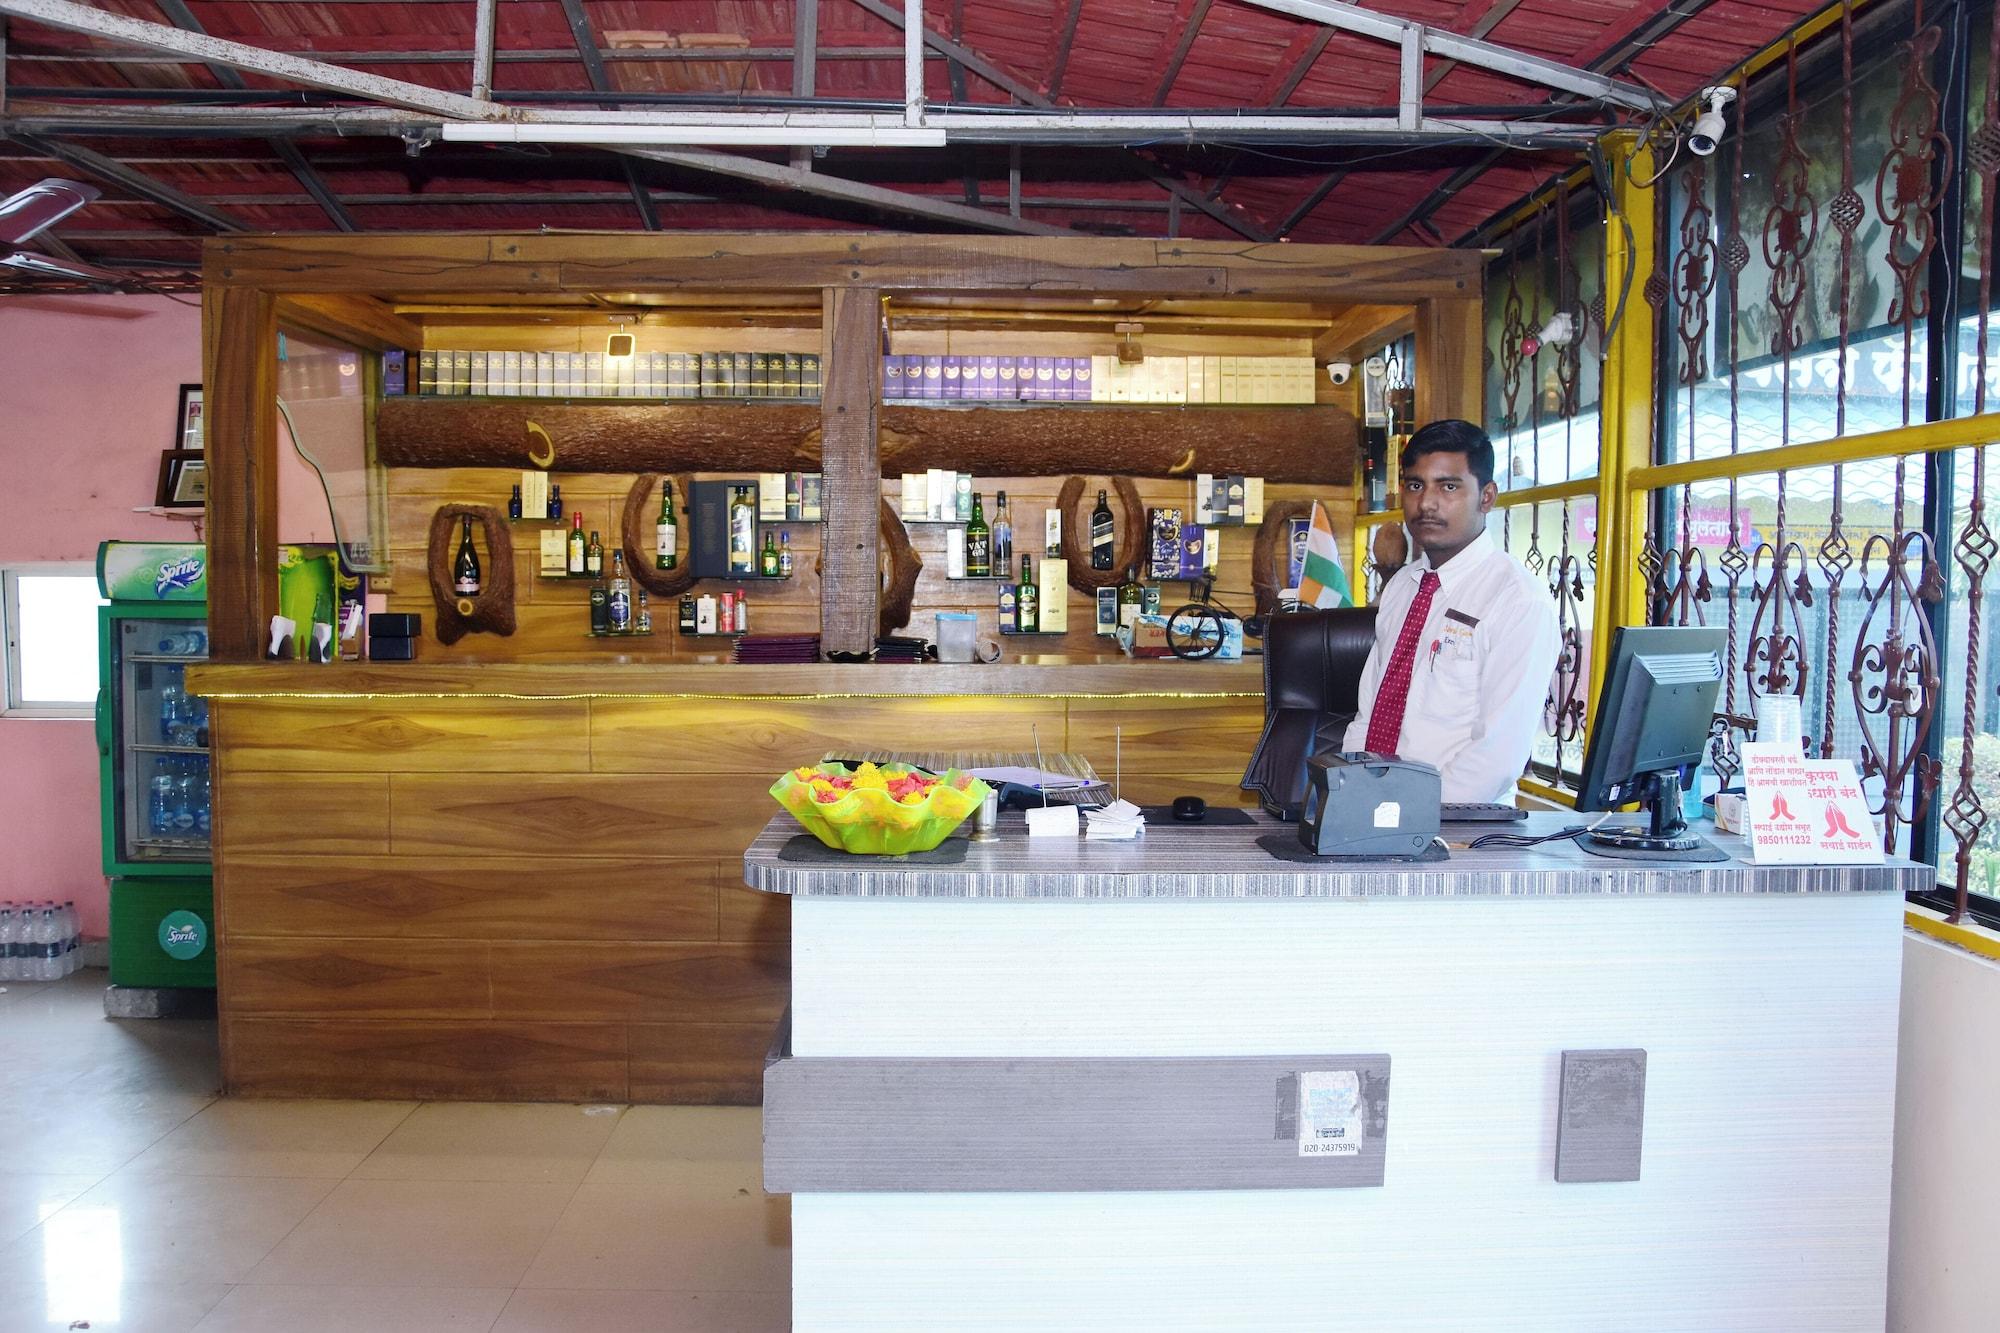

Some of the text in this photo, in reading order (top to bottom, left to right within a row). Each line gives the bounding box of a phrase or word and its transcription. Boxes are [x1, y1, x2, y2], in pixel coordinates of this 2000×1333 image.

[968, 540, 987, 550] VAT
[157, 560, 199, 582] Sprite
[1805, 771, 1838, 785] कृपया
[1839, 785, 1857, 798] बंद
[1757, 835, 1812, 845] 9850111232
[167, 930, 198, 944] Sprite
